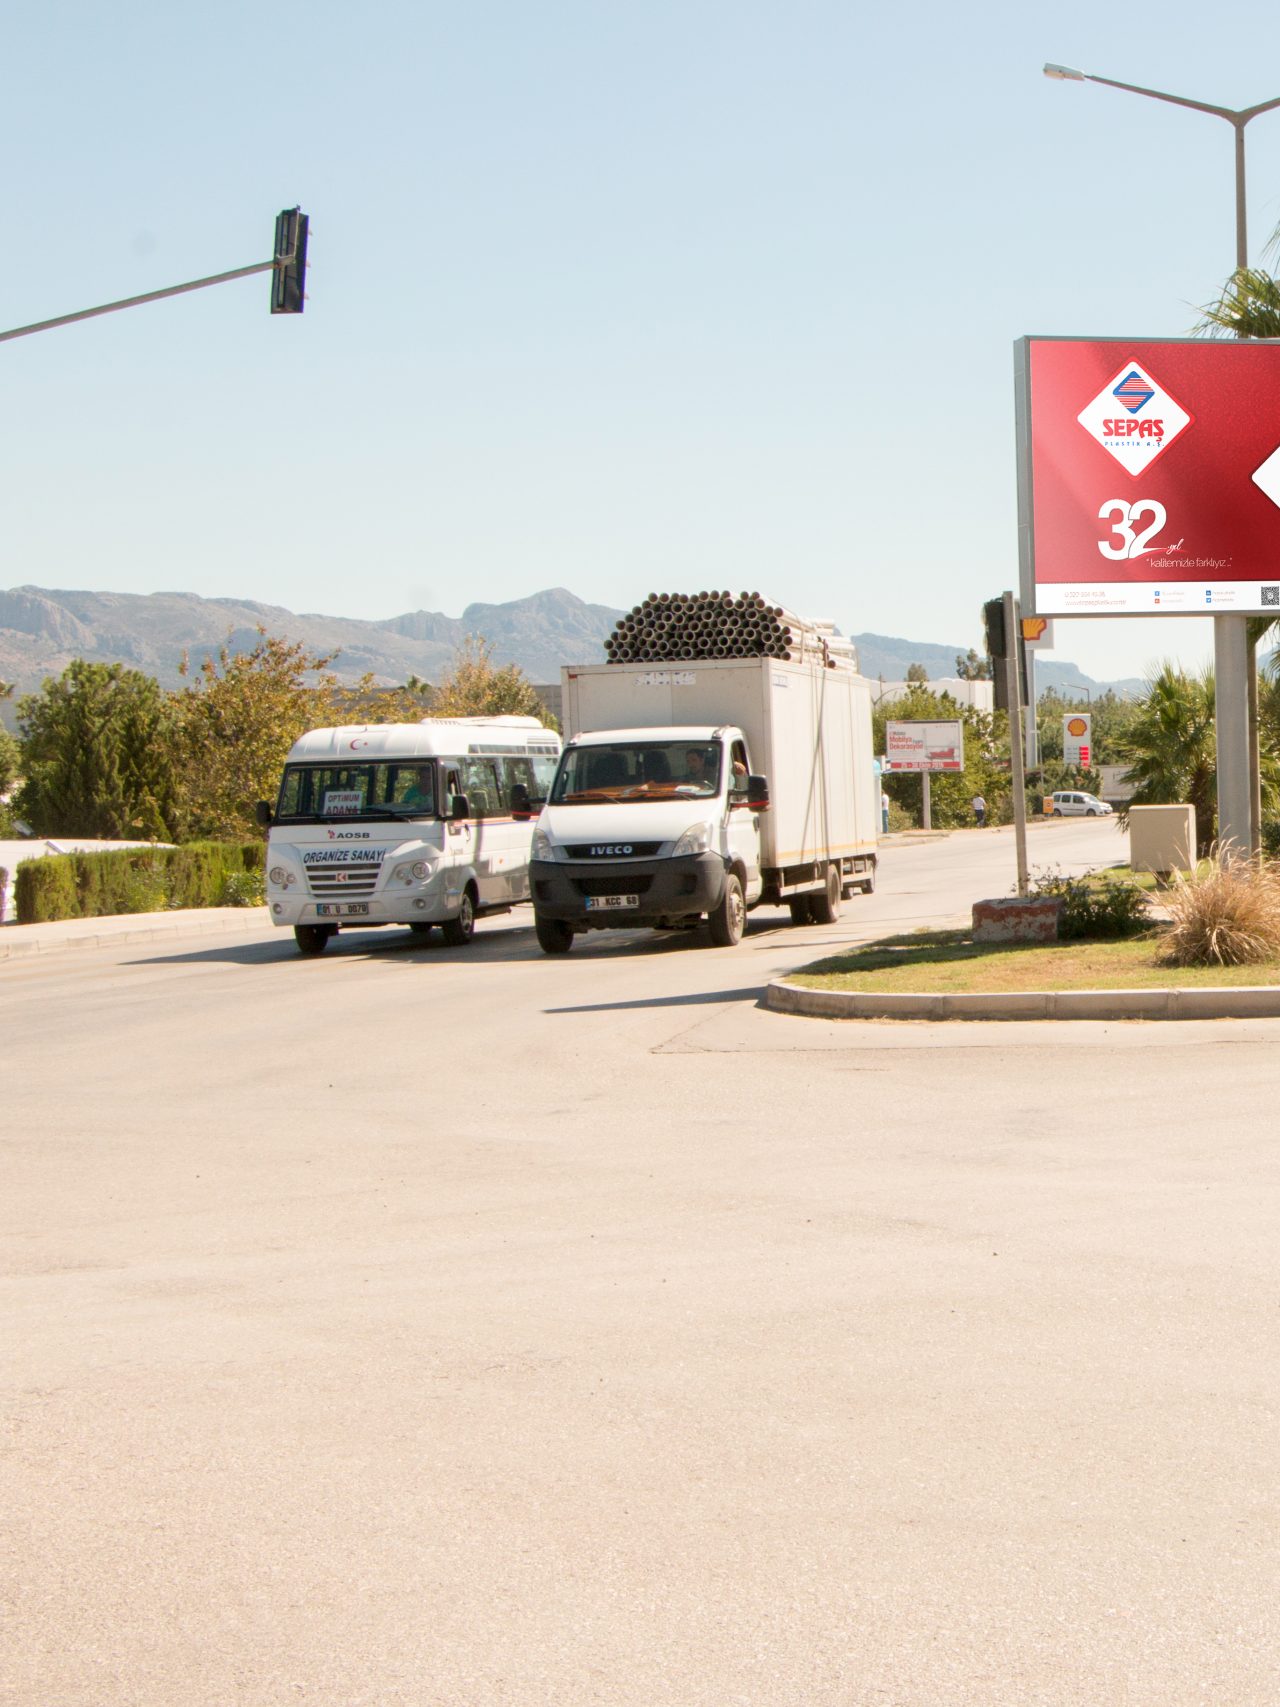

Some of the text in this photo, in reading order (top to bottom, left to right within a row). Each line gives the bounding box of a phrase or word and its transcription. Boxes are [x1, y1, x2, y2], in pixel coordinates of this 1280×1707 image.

[1102, 419, 1165, 442] SEPAŞ
[1098, 499, 1167, 560] 32
[303, 848, 387, 864] ORGANİZE SANAYİ
[591, 846, 632, 855] IVECO
